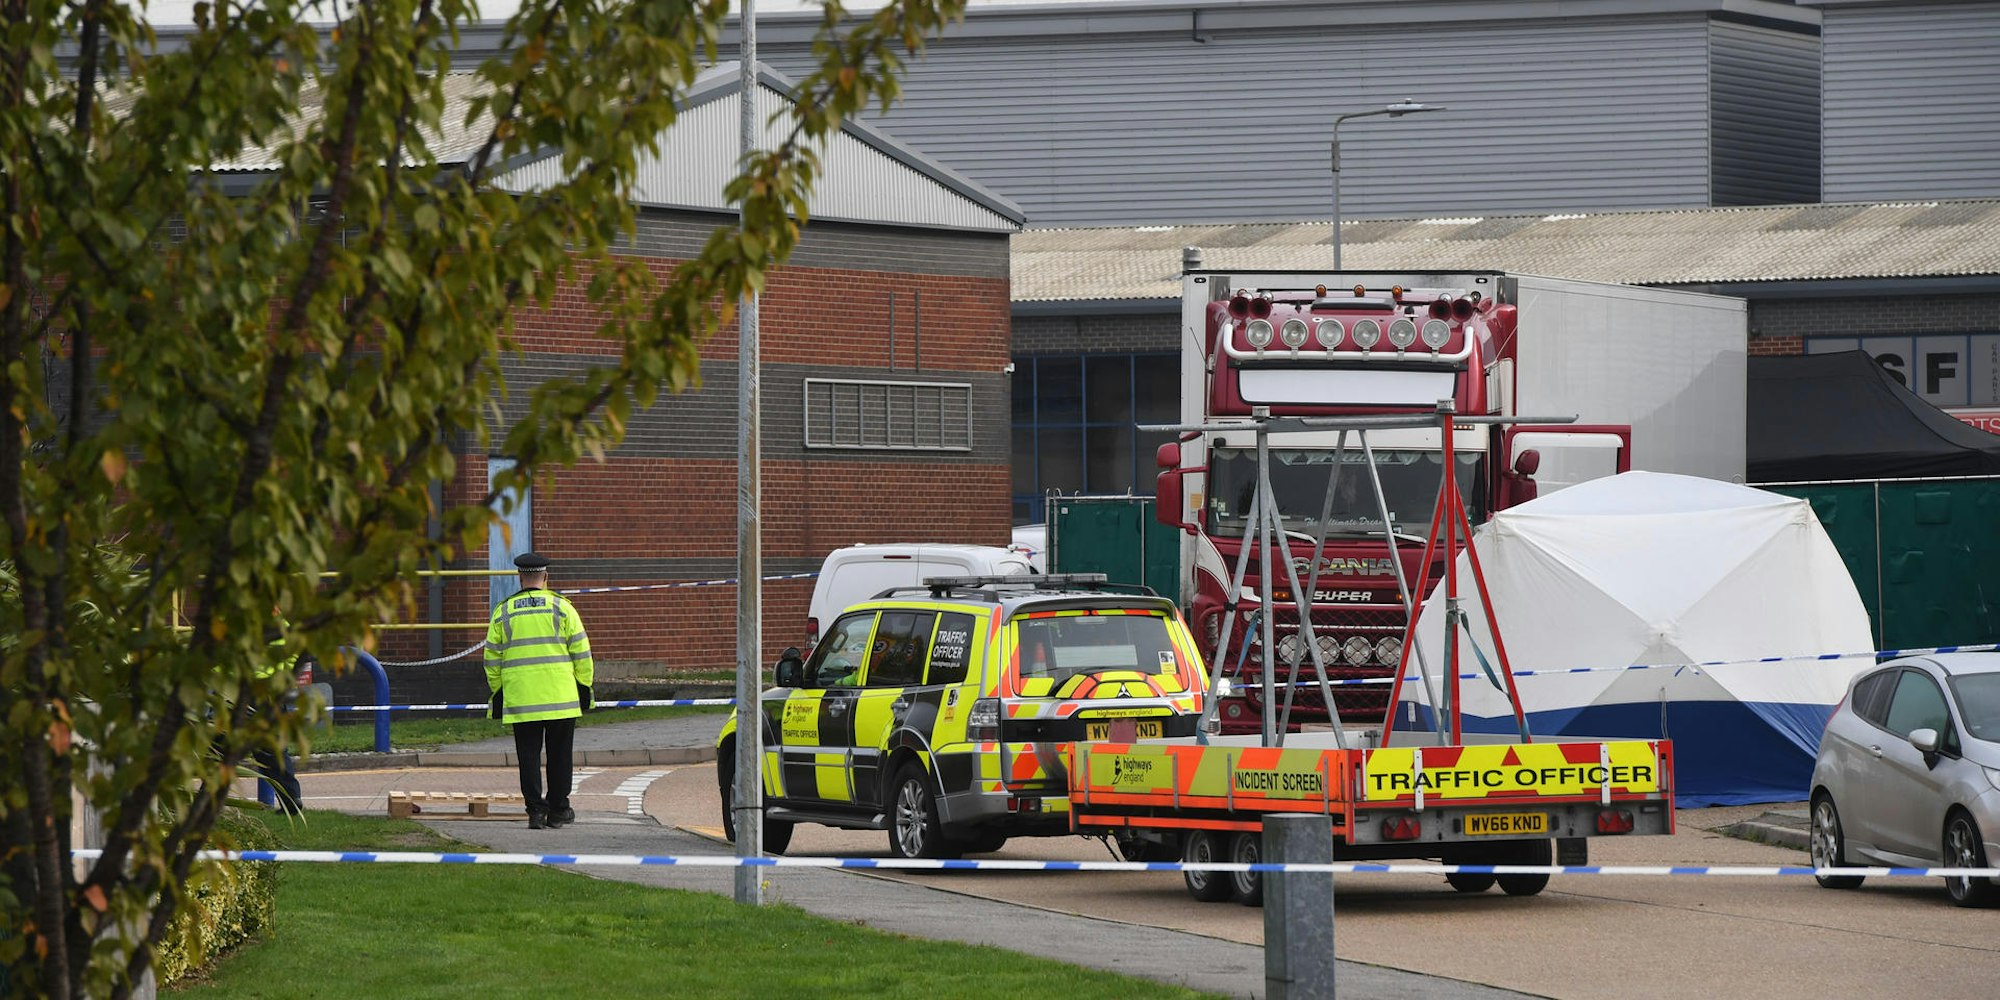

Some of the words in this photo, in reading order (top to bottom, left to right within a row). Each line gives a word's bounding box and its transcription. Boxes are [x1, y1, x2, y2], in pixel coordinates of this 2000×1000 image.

[1327, 518, 1357, 526] ltimate
[1292, 556, 1396, 576] SCANIA
[515, 597, 545, 608] POLCE
[1312, 590, 1372, 601] SUPER
[937, 630, 967, 644] TRAFFIC
[932, 645, 964, 659] OFFICER
[1096, 710, 1127, 718] highways
[1128, 709, 1153, 717] england
[783, 729, 800, 738] TRAFFIC
[800, 730, 817, 738] OFFICER
[1137, 723, 1157, 737] ND
[1123, 756, 1152, 774] highways
[1123, 773, 1145, 784] england
[1234, 770, 1279, 790] INCIDENT
[1282, 772, 1322, 792] SCREEN
[1369, 769, 1503, 790] TRAFFIC
[1515, 765, 1652, 786] OFFICER
[1471, 816, 1509, 832] WV66
[1513, 815, 1541, 831] KND
